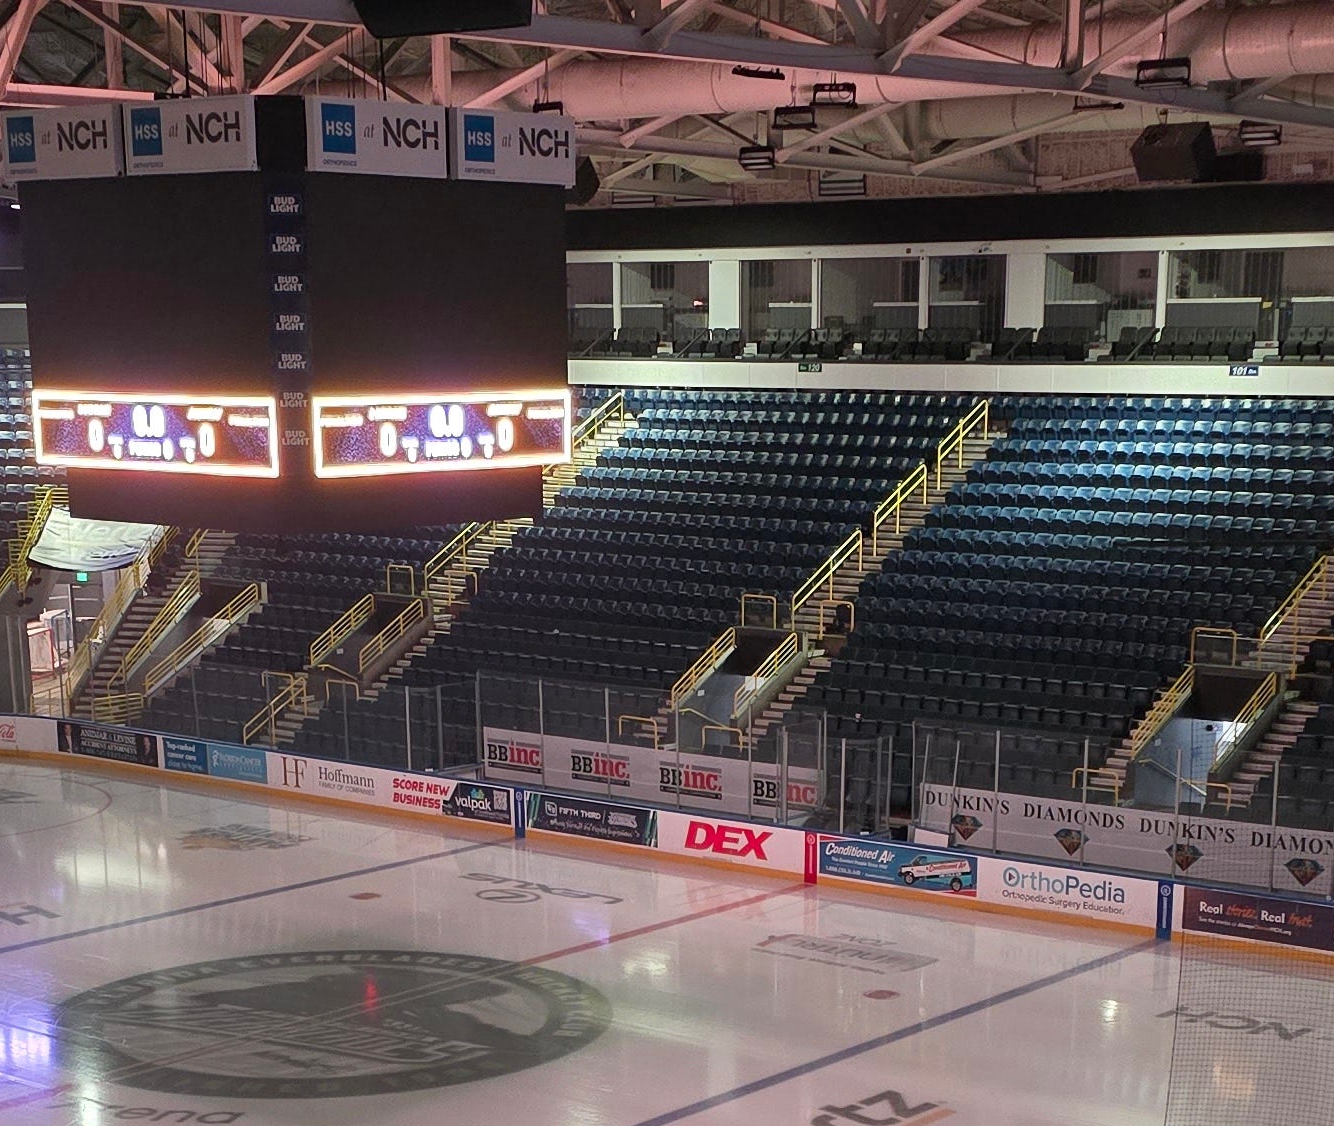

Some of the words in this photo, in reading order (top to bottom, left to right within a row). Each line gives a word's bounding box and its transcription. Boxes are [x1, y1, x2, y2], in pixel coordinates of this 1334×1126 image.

[134, 124, 158, 140] HSS
[186, 111, 241, 145] NCH
[325, 120, 352, 137] HSS
[363, 124, 374, 138] at
[382, 116, 439, 150] NCH
[10, 132, 32, 147] HSS
[56, 119, 108, 152] NCH
[467, 132, 492, 147] HSS
[519, 127, 569, 158] NCH
[274, 196, 295, 205] BUD
[270, 204, 299, 213] LIGHT
[276, 236, 297, 244] BUD
[272, 244, 301, 252] LIGHT
[277, 276, 298, 284] BUD
[274, 283, 303, 292] LIGHT
[279, 315, 300, 323] BUD
[276, 322, 305, 331] LIGHT
[278, 361, 306, 369] LIGHT
[808, 363, 821, 372] 120
[1232, 366, 1248, 376] 101
[283, 392, 304, 400] BUD
[280, 400, 308, 408] LIGHT
[285, 430, 306, 438] BUD
[282, 438, 310, 446] LIGHT
[318, 766, 375, 789] Hoffmann
[392, 778, 424, 795] SCORE
[426, 783, 450, 797] NEW
[393, 793, 442, 810] BUSINESS
[455, 795, 492, 812] valpak
[558, 806, 579, 816] FIFTH
[580, 809, 602, 820] THIRD
[924, 789, 1011, 815] DUNKIN'S
[1023, 803, 1126, 831] DIAMONDS
[685, 820, 773, 861] DEX
[825, 843, 879, 860] Conditioned
[878, 850, 896, 863] Air
[1002, 866, 1126, 904] OrthoPedia
[1002, 889, 1047, 903] Orthopedic
[1049, 896, 1081, 911] Surgery
[1199, 901, 1224, 915] Real
[1261, 910, 1286, 924] Real
